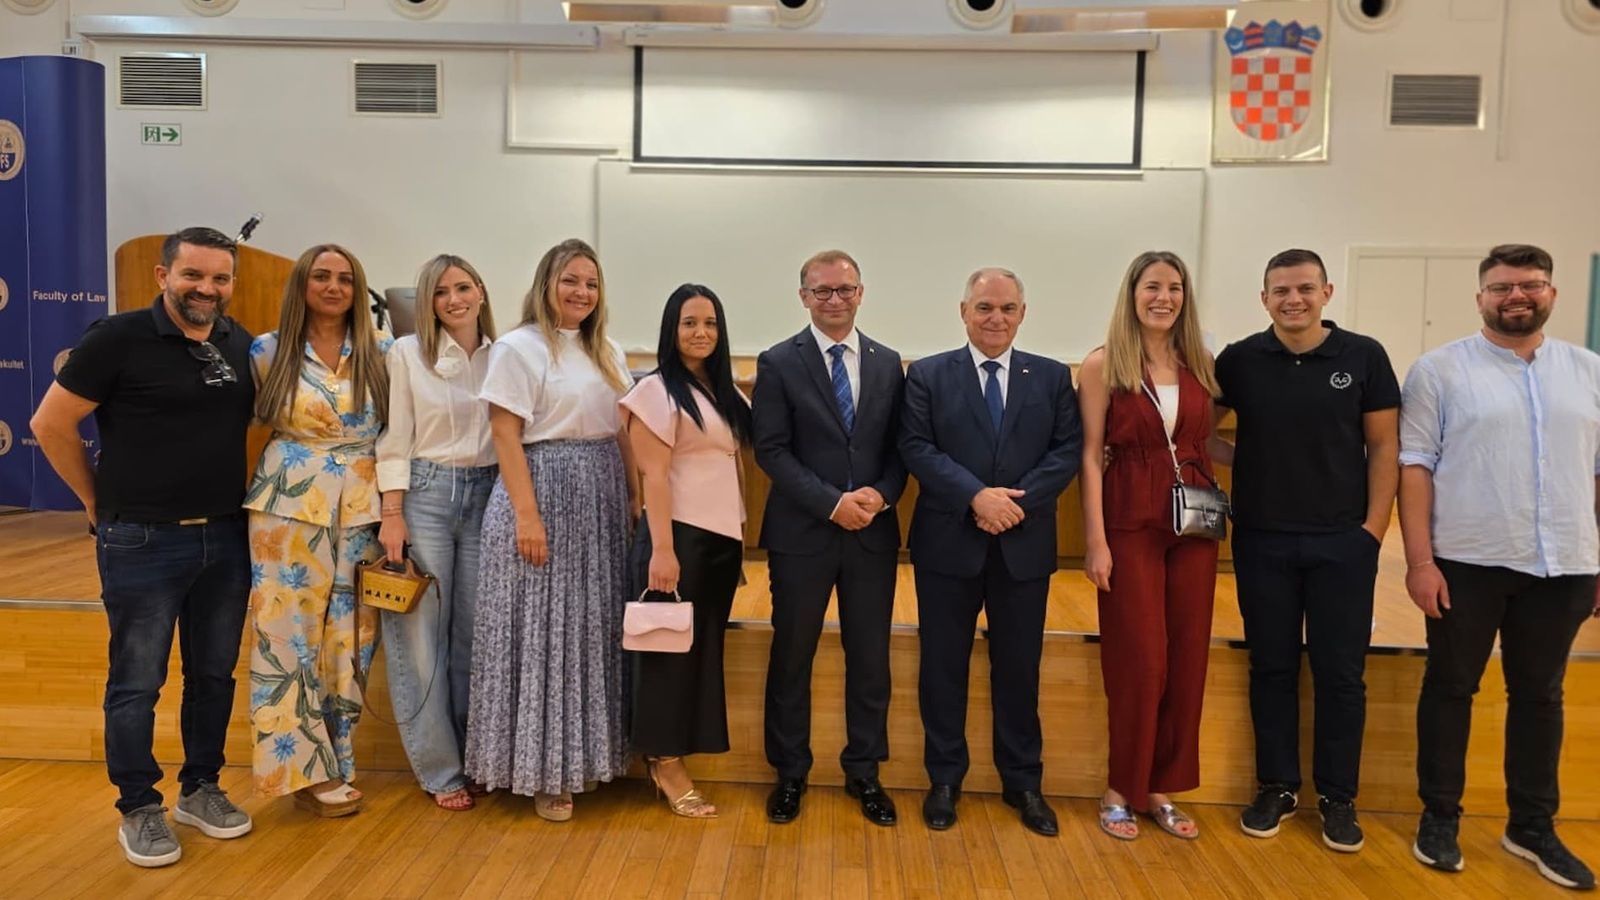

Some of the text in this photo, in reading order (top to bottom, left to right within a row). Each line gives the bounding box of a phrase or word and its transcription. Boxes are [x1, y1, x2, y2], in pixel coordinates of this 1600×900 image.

[0, 154, 9, 169] FS
[32, 290, 107, 303] Faculty of Law
